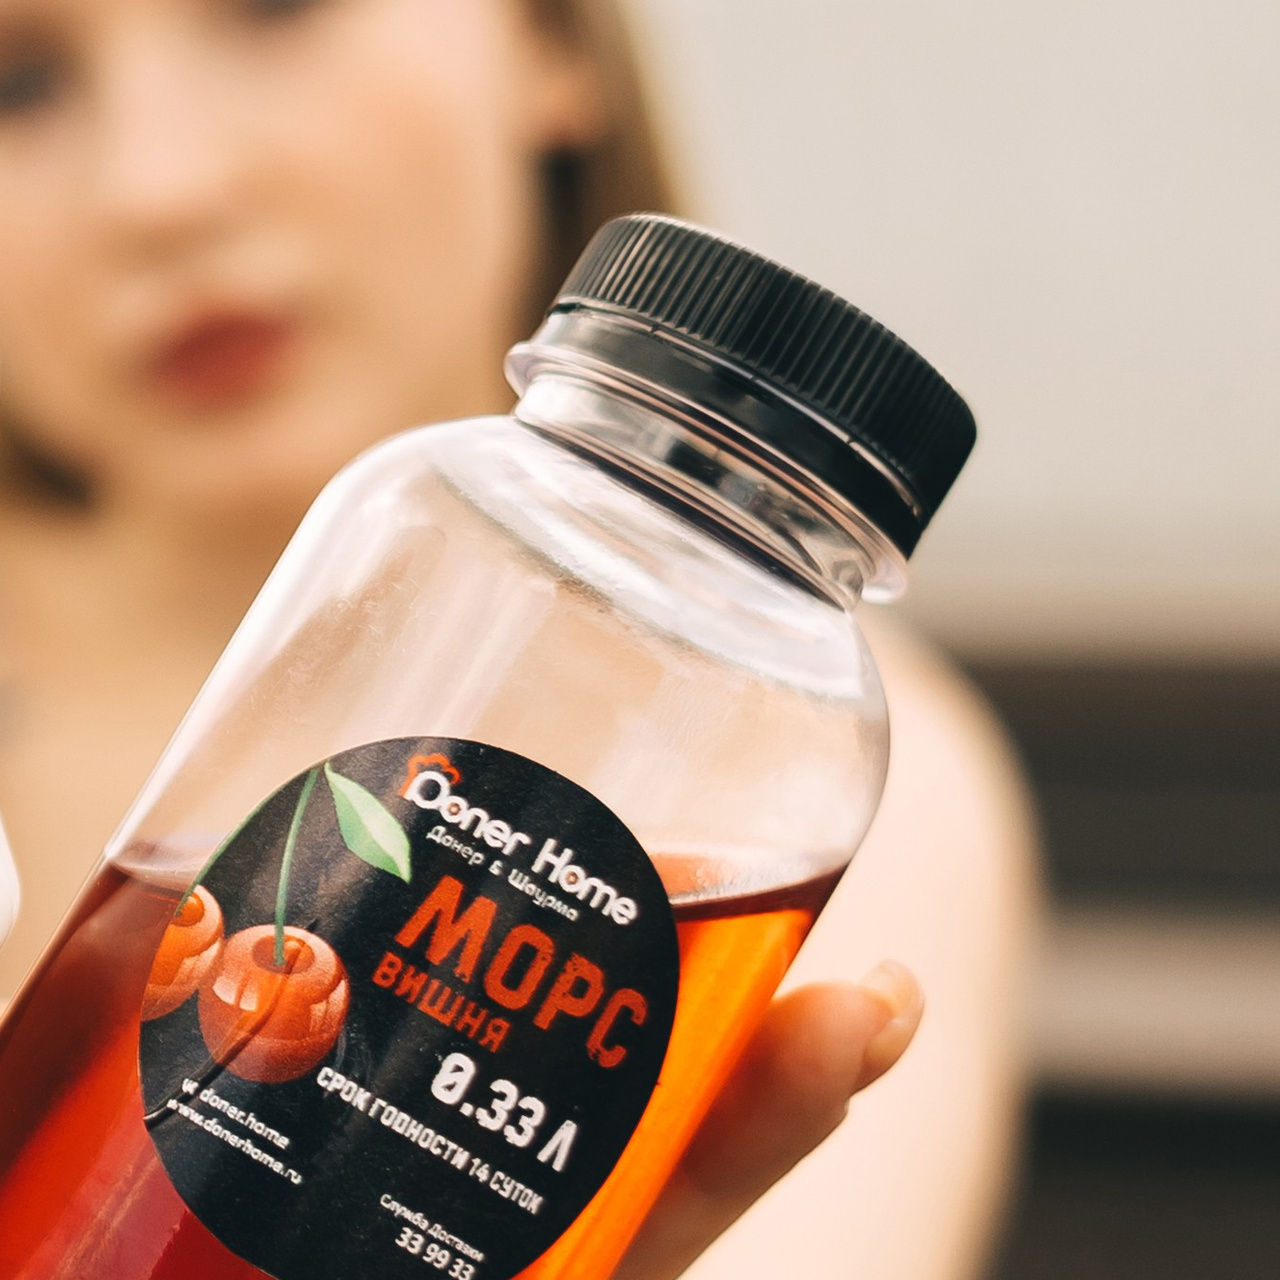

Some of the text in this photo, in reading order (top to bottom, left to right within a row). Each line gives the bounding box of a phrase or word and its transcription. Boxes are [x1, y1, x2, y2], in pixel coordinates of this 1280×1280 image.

[405, 770, 639, 926] Doner Home
[425, 825, 486, 866] Донер
[507, 868, 581, 922] Шаурма
[371, 951, 511, 1054] ВИШНЯ
[394, 873, 649, 1069] МОРС
[198, 1087, 291, 1150] doner.home
[316, 1065, 545, 1215] СРОК ГОДНОСТИ 14 СУТОК
[430, 1051, 580, 1173] 0.33 Л
[380, 1193, 486, 1262] Служба Доставки
[394, 1226, 425, 1255] 33
[422, 1242, 451, 1270] 99
